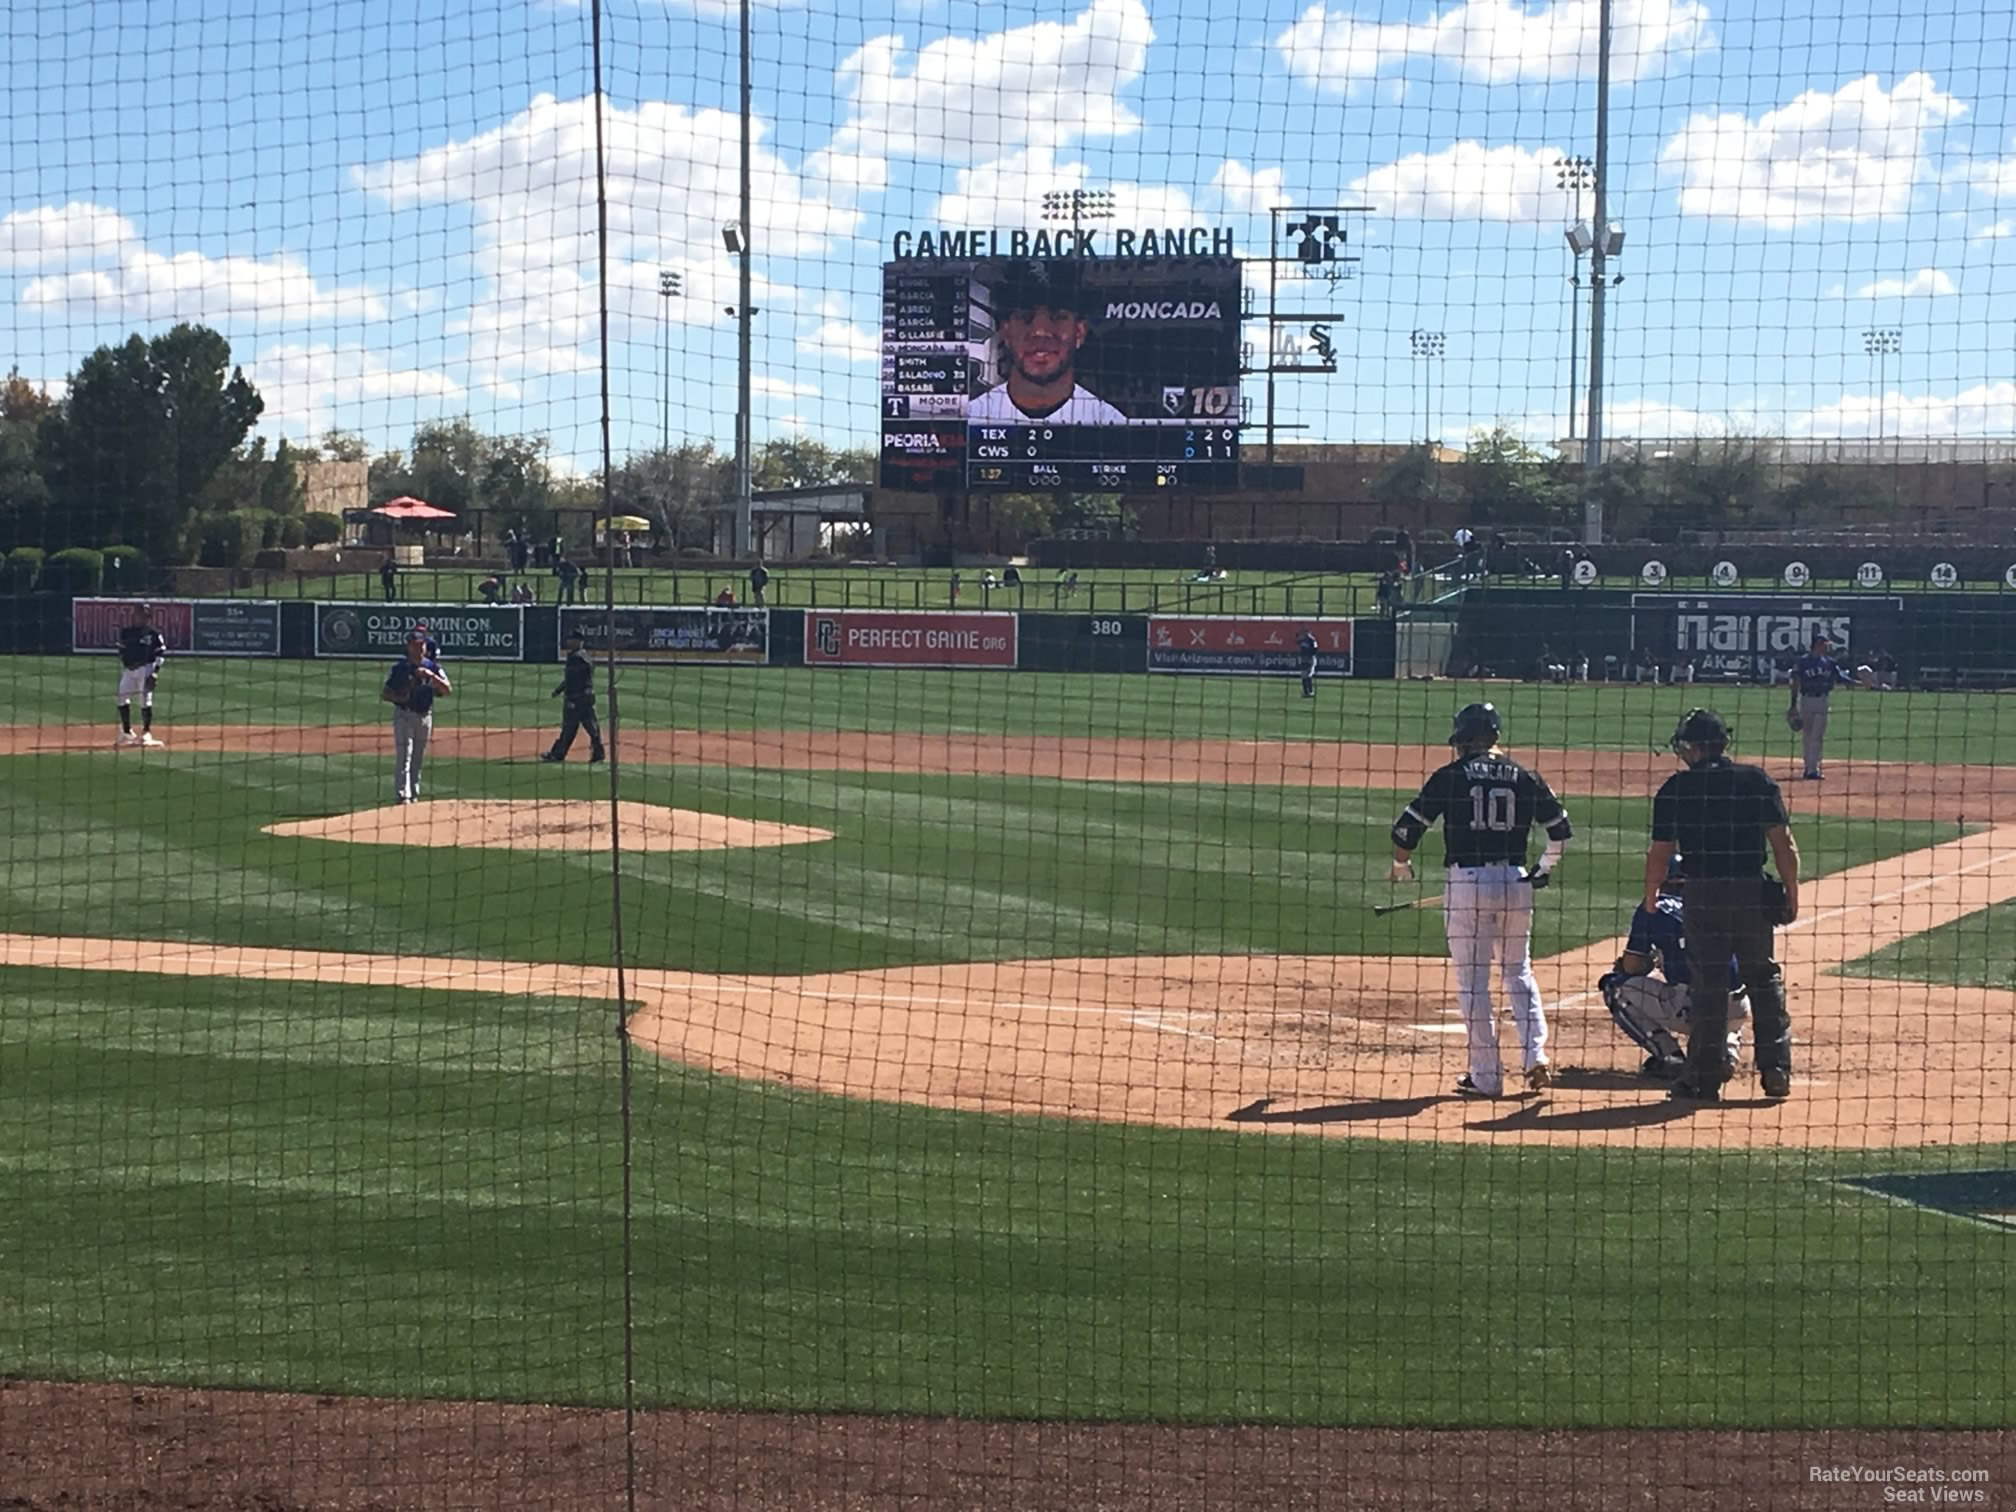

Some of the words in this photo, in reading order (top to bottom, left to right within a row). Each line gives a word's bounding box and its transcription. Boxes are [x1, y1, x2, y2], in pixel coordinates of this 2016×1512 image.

[1115, 227, 1233, 257] RANCH
[1105, 301, 1221, 319] MONCADA
[899, 370, 946, 379] SALADINO
[919, 397, 957, 405] MOORE
[1191, 387, 1229, 414] 10
[884, 433, 940, 447] PEORIA
[981, 429, 1007, 440] TEX
[1028, 429, 1036, 440] 2
[1043, 429, 1053, 440] 0
[1186, 430, 1194, 441] 2
[1204, 429, 1213, 441] 2
[1222, 429, 1233, 440] 0
[978, 446, 1009, 457] CWS
[1027, 445, 1037, 457] 0
[1184, 447, 1195, 458] 0
[1206, 445, 1212, 458] 1
[1225, 445, 1231, 458] 1
[1033, 465, 1058, 473] BALL
[1092, 465, 1127, 473] STRIKE
[1157, 465, 1177, 473] OUT
[1580, 565, 1589, 576] 2
[1650, 565, 1659, 576] 3
[1720, 565, 1729, 576] 4
[1863, 566, 1877, 578] 11
[76, 604, 186, 649] VICTRY
[367, 615, 401, 630] OLD
[405, 617, 491, 632] DOMINION
[1091, 620, 1122, 635] 380
[848, 628, 922, 648] PERFECT
[926, 629, 979, 650] GAME
[1470, 785, 1515, 831] 10
